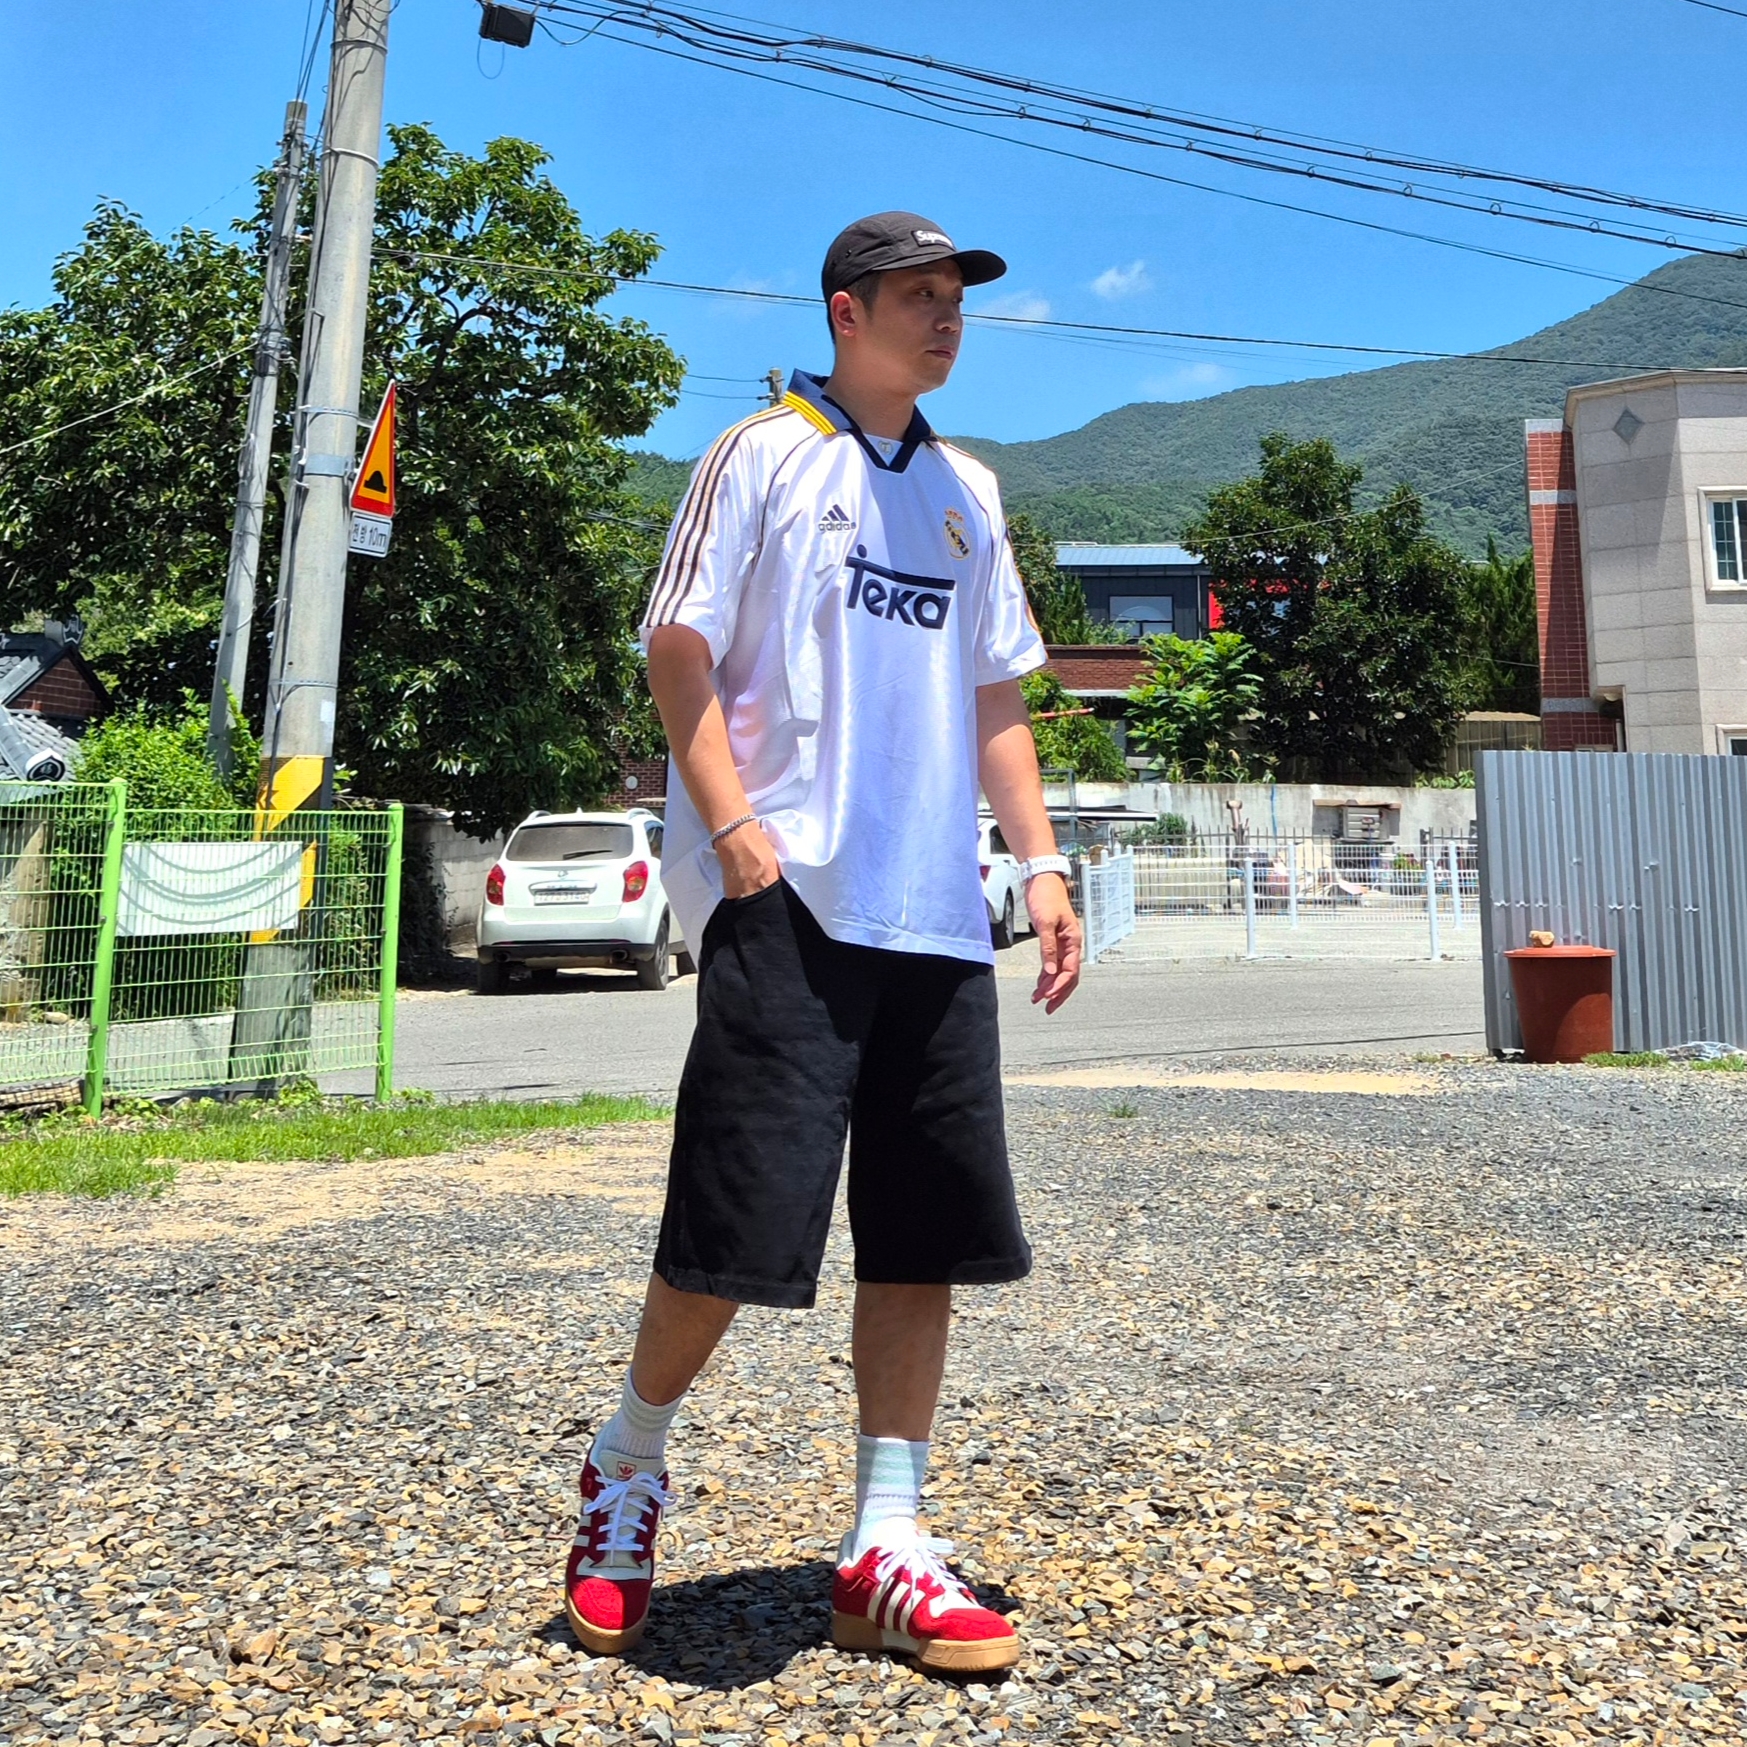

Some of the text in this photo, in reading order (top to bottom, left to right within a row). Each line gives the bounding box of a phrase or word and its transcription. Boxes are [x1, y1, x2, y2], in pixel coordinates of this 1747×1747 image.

[369, 526, 387, 547] 10m
[818, 521, 857, 532] adidas
[844, 544, 956, 630] Teka
